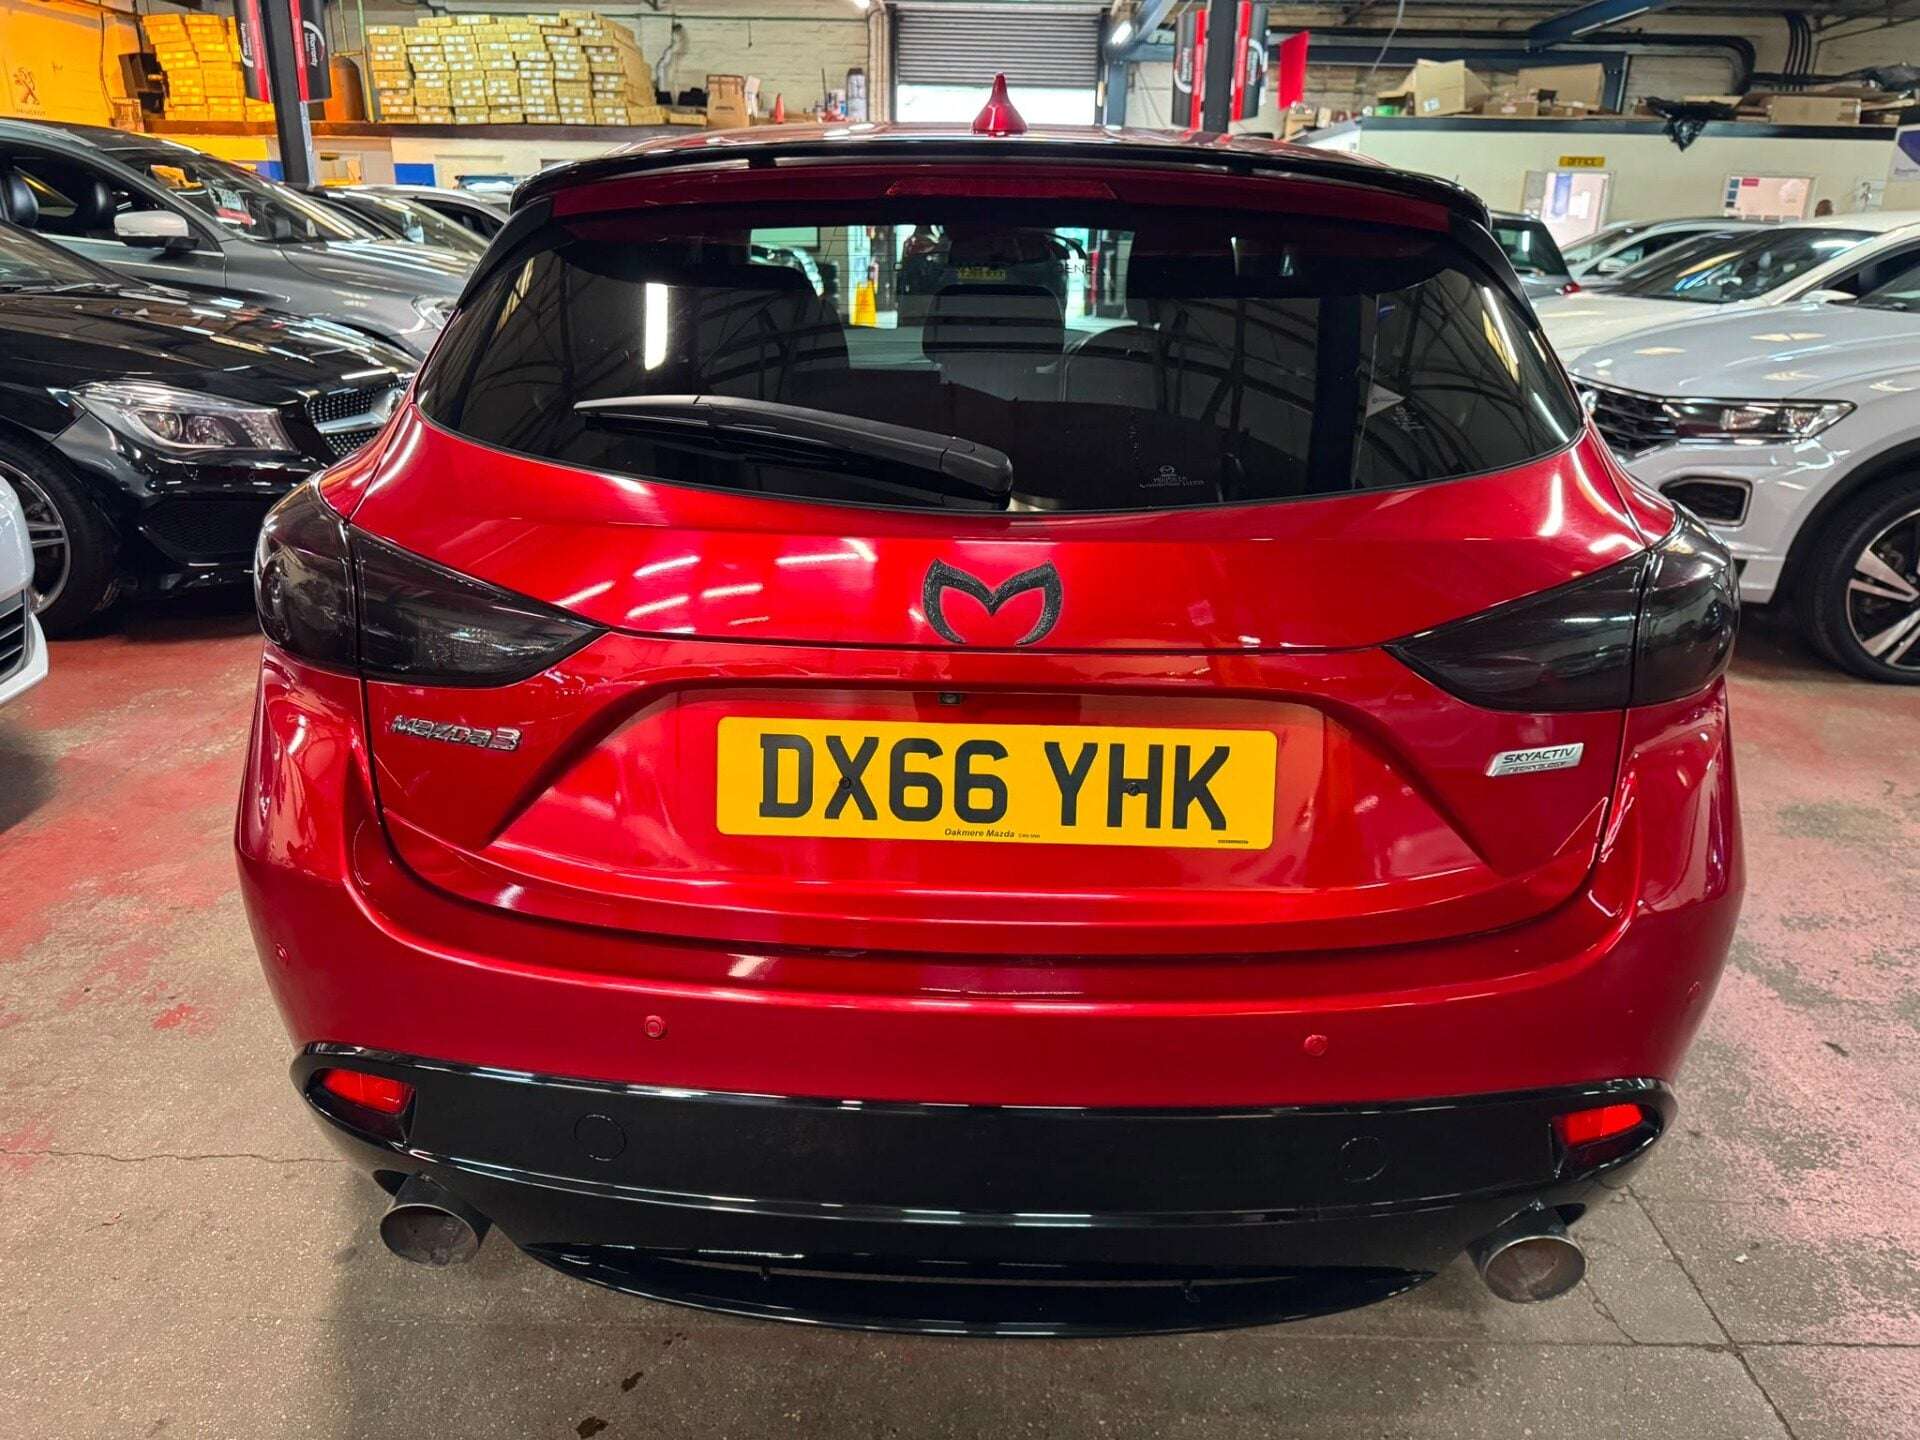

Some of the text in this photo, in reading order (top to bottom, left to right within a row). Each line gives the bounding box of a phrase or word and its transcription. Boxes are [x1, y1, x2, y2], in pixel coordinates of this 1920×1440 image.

[1503, 747, 1576, 764] SKYACTIV
[759, 733, 1231, 831] DX66 YHK
[944, 828, 984, 837] Oakmere
[986, 830, 1015, 838] Mazda
